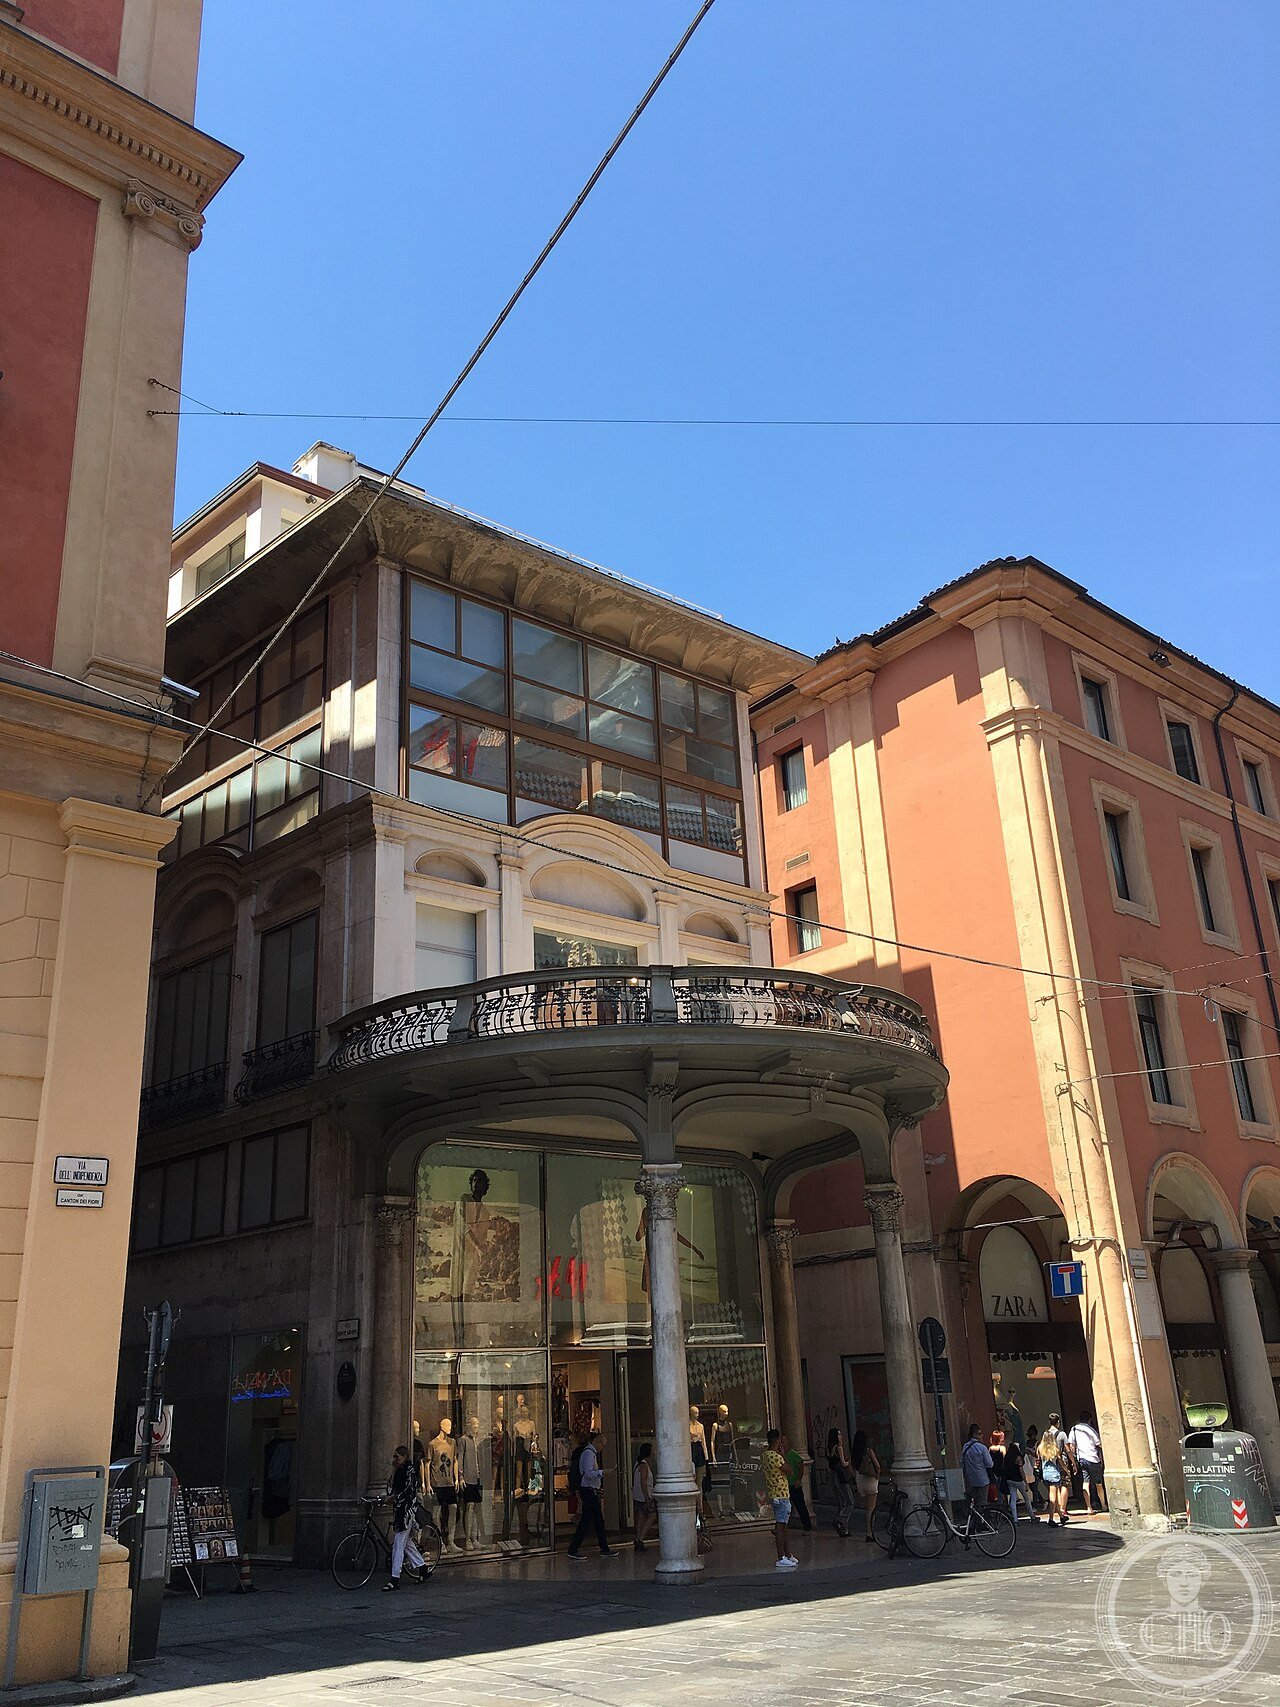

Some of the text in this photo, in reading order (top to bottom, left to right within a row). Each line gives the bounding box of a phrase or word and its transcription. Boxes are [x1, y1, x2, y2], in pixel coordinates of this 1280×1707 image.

[78, 1161, 86, 1170] VIA
[991, 1295, 1038, 1317] ZARA
[1202, 1465, 1236, 1474] LATTINE
